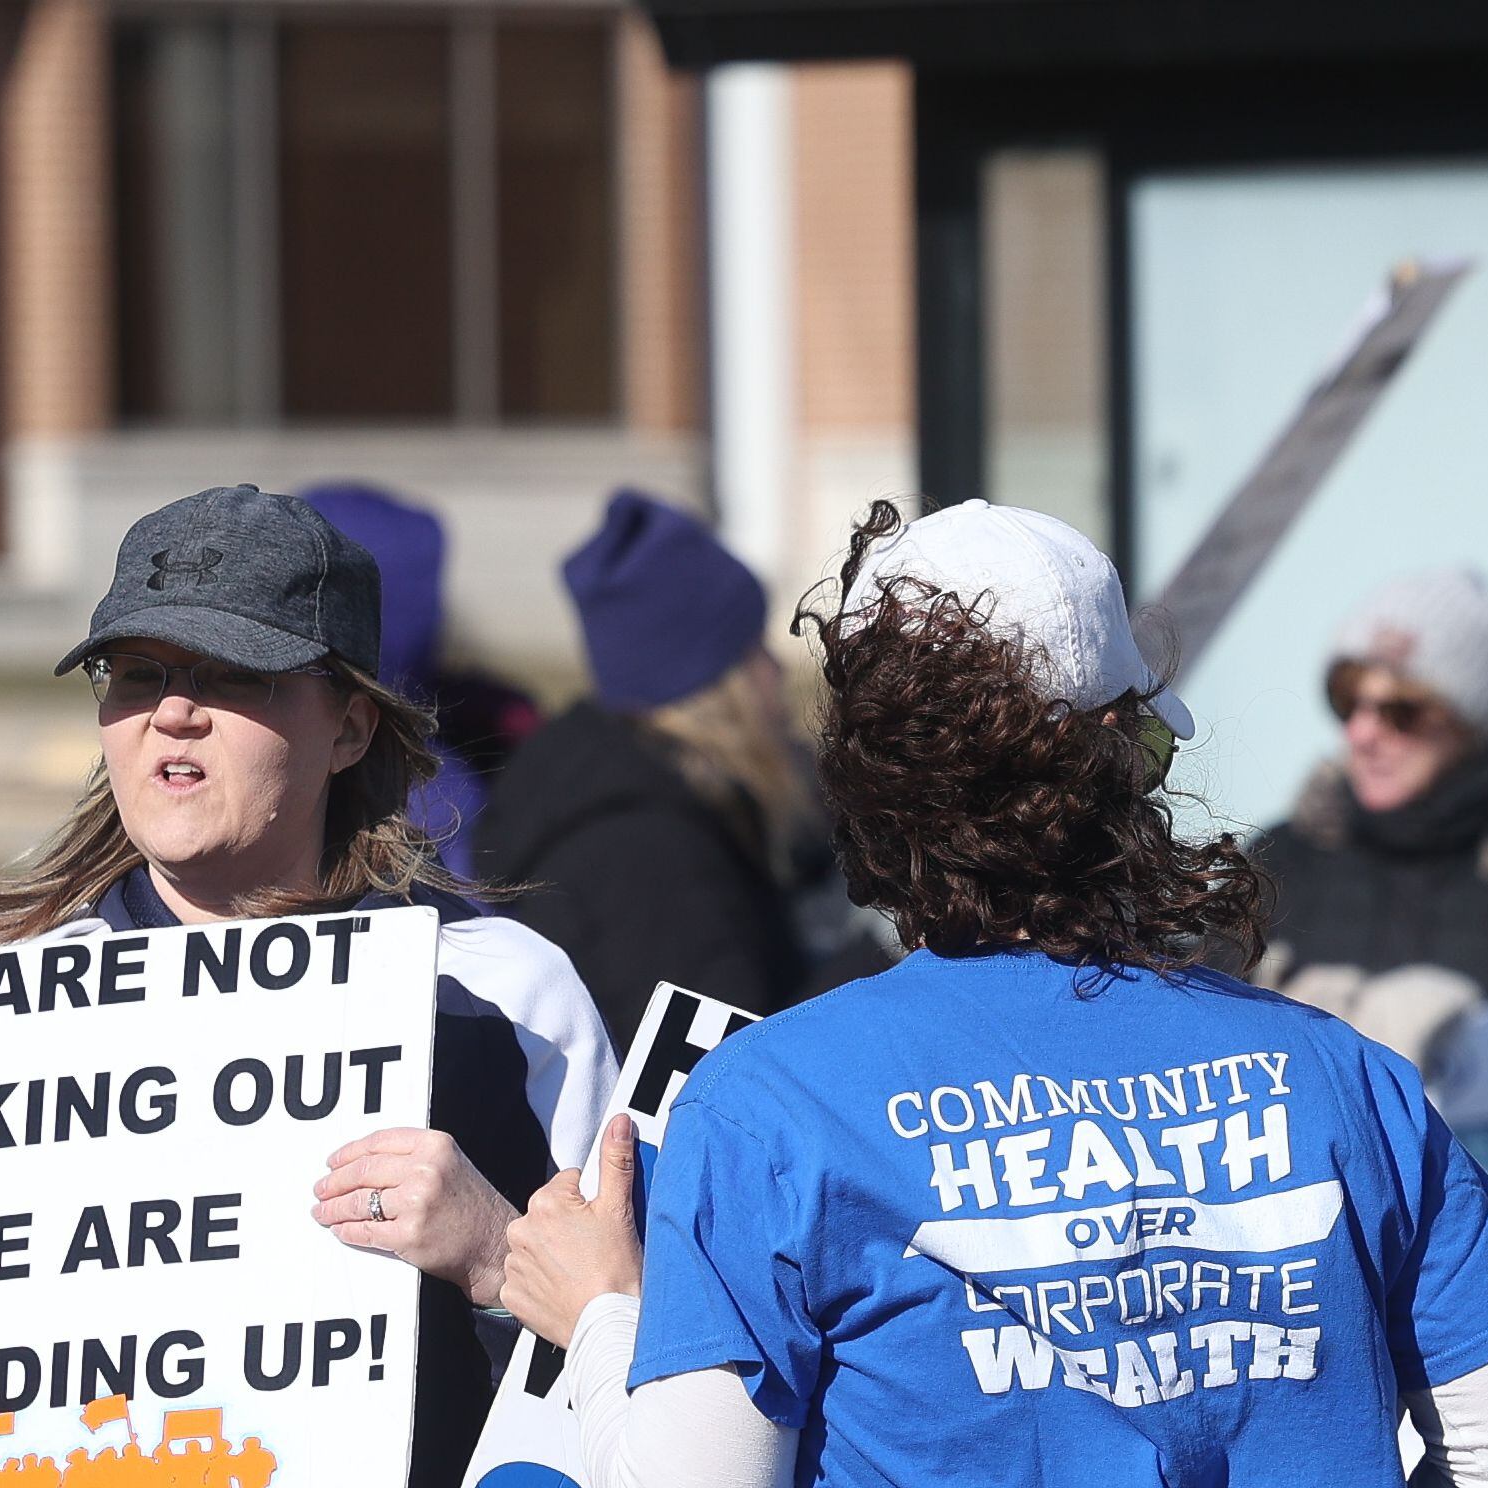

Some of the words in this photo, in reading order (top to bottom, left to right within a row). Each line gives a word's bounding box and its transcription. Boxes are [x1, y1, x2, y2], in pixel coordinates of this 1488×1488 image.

[181, 917, 371, 997] NOT
[212, 1045, 402, 1126] OUT
[887, 1052, 1291, 1138] COMMUNITY
[929, 1103, 1292, 1212] HEALTH
[61, 1193, 242, 1274] ARE
[1065, 1207, 1196, 1248] OVER
[242, 1314, 388, 1391] UP!
[961, 1320, 1321, 1408] WEALTH
